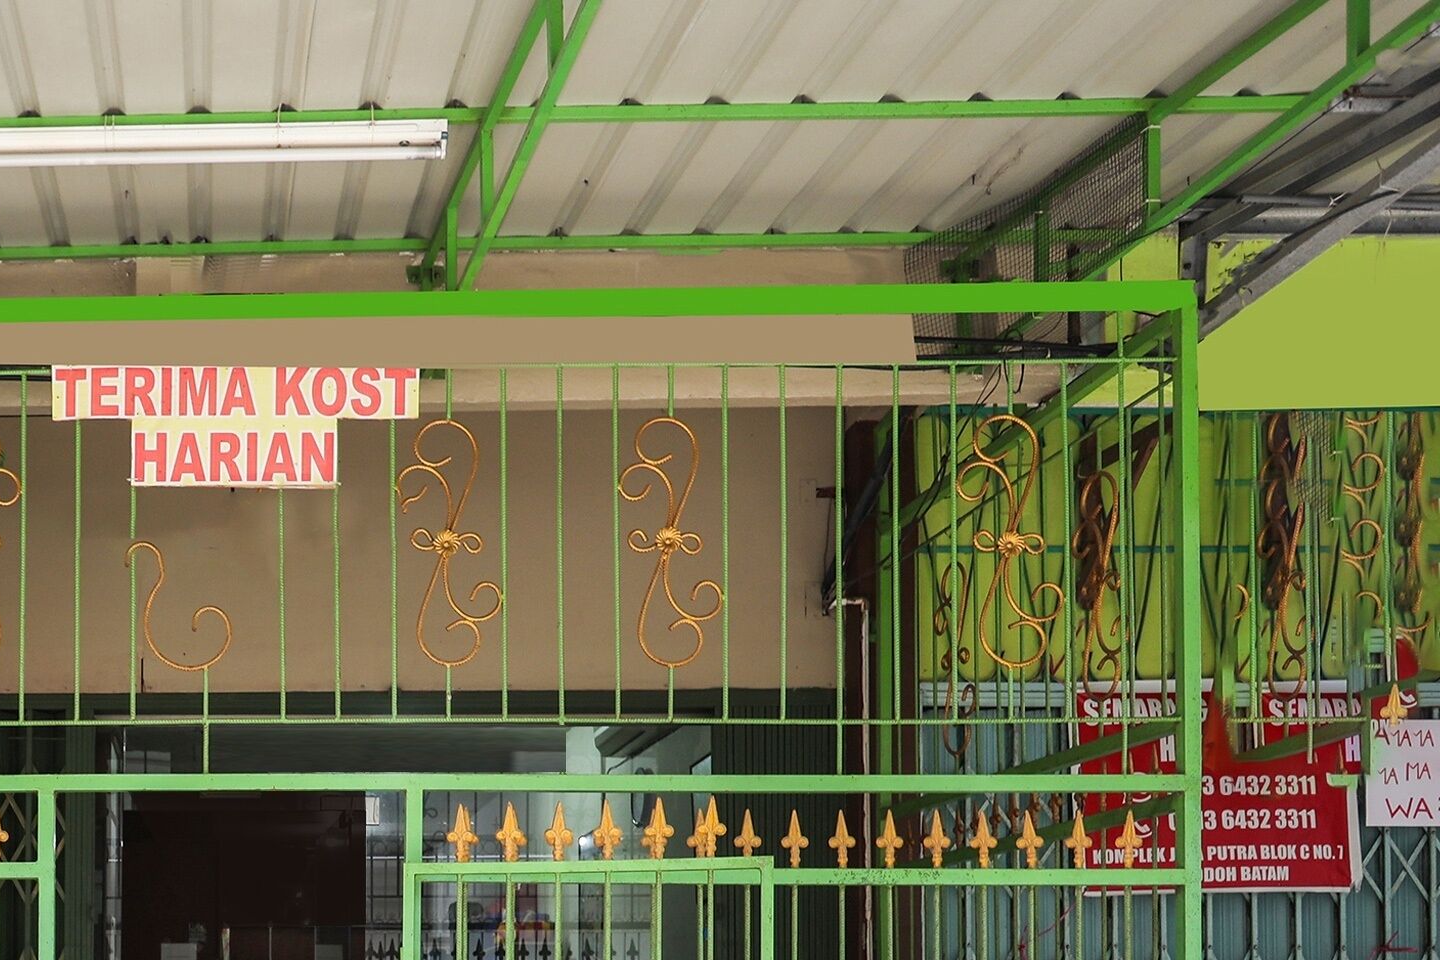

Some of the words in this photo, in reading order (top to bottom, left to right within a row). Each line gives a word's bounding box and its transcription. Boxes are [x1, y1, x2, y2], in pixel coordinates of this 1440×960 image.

[54, 367, 256, 417] TERIMA
[275, 366, 417, 417] KOST
[134, 432, 335, 482] HARIAN
[1220, 776, 1271, 795] 6432
[1275, 775, 1316, 795] 3311
[1221, 809, 1271, 829] 6432
[1275, 809, 1316, 829] 3311
[1207, 846, 1256, 861] PUTRA
[1261, 845, 1297, 860] BLOK
[1300, 844, 1309, 858] C
[1313, 844, 1336, 859] NO.
[1338, 844, 1343, 858] 7
[1241, 866, 1289, 881] BATAM
